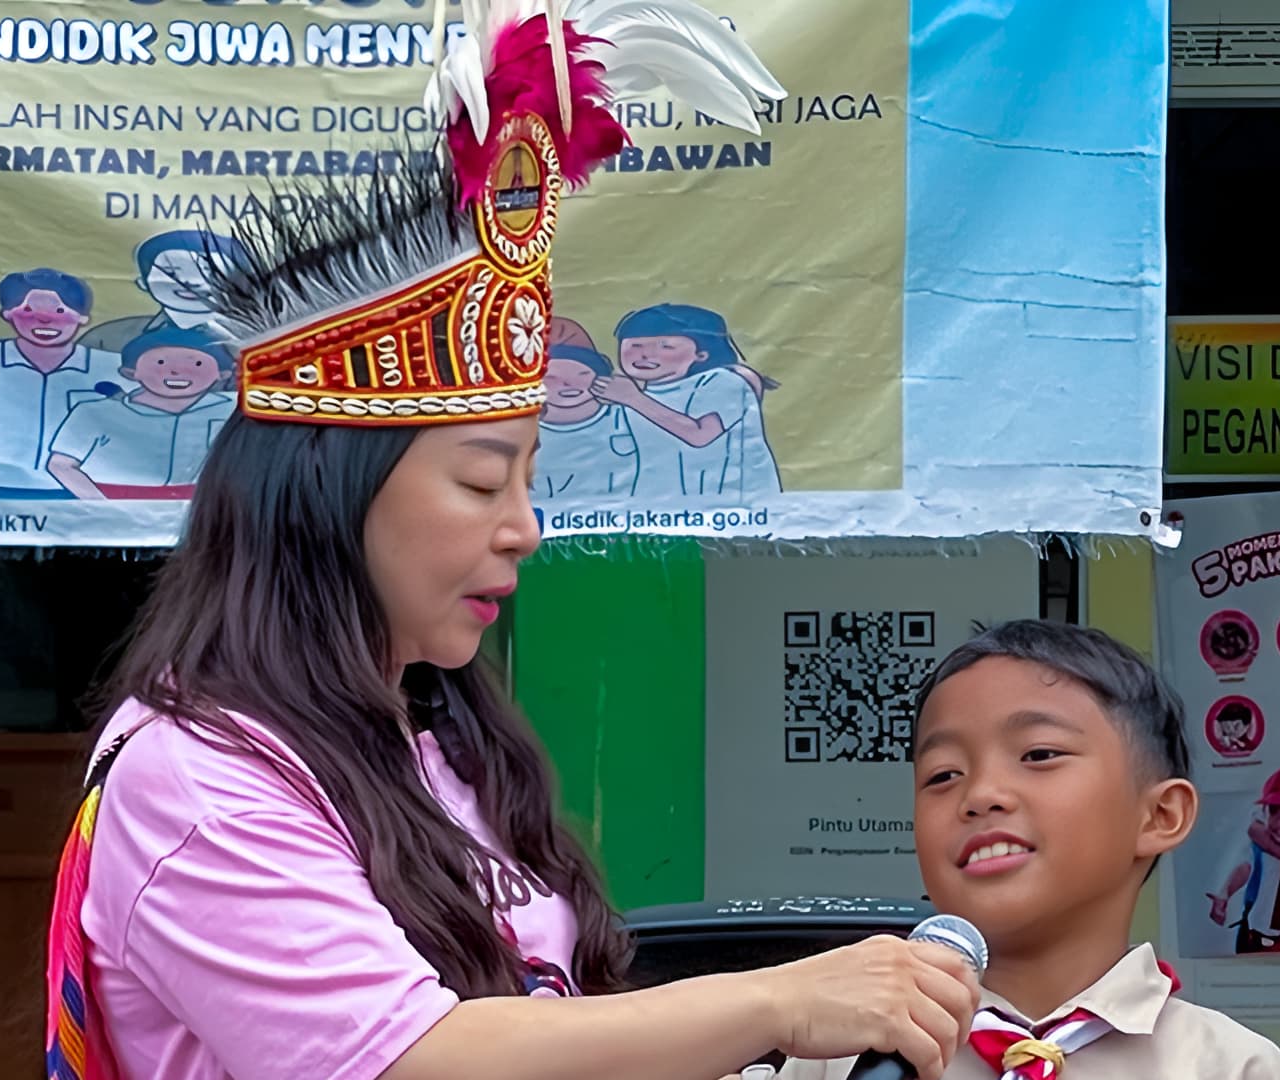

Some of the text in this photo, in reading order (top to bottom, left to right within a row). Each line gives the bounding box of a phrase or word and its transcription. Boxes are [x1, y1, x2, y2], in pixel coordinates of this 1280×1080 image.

[166, 20, 295, 66] JIWA
[74, 103, 183, 132] INSAN
[196, 105, 300, 133] YANG
[794, 94, 882, 124] JAGA
[182, 150, 404, 176] MARTABAT
[105, 192, 139, 218] DI
[152, 194, 262, 222] MANA
[1176, 344, 1252, 381] VISI
[551, 508, 768, 532] disdik.jakarta.go.id
[1194, 551, 1229, 597] 5
[808, 817, 914, 833] Pintu Utama
